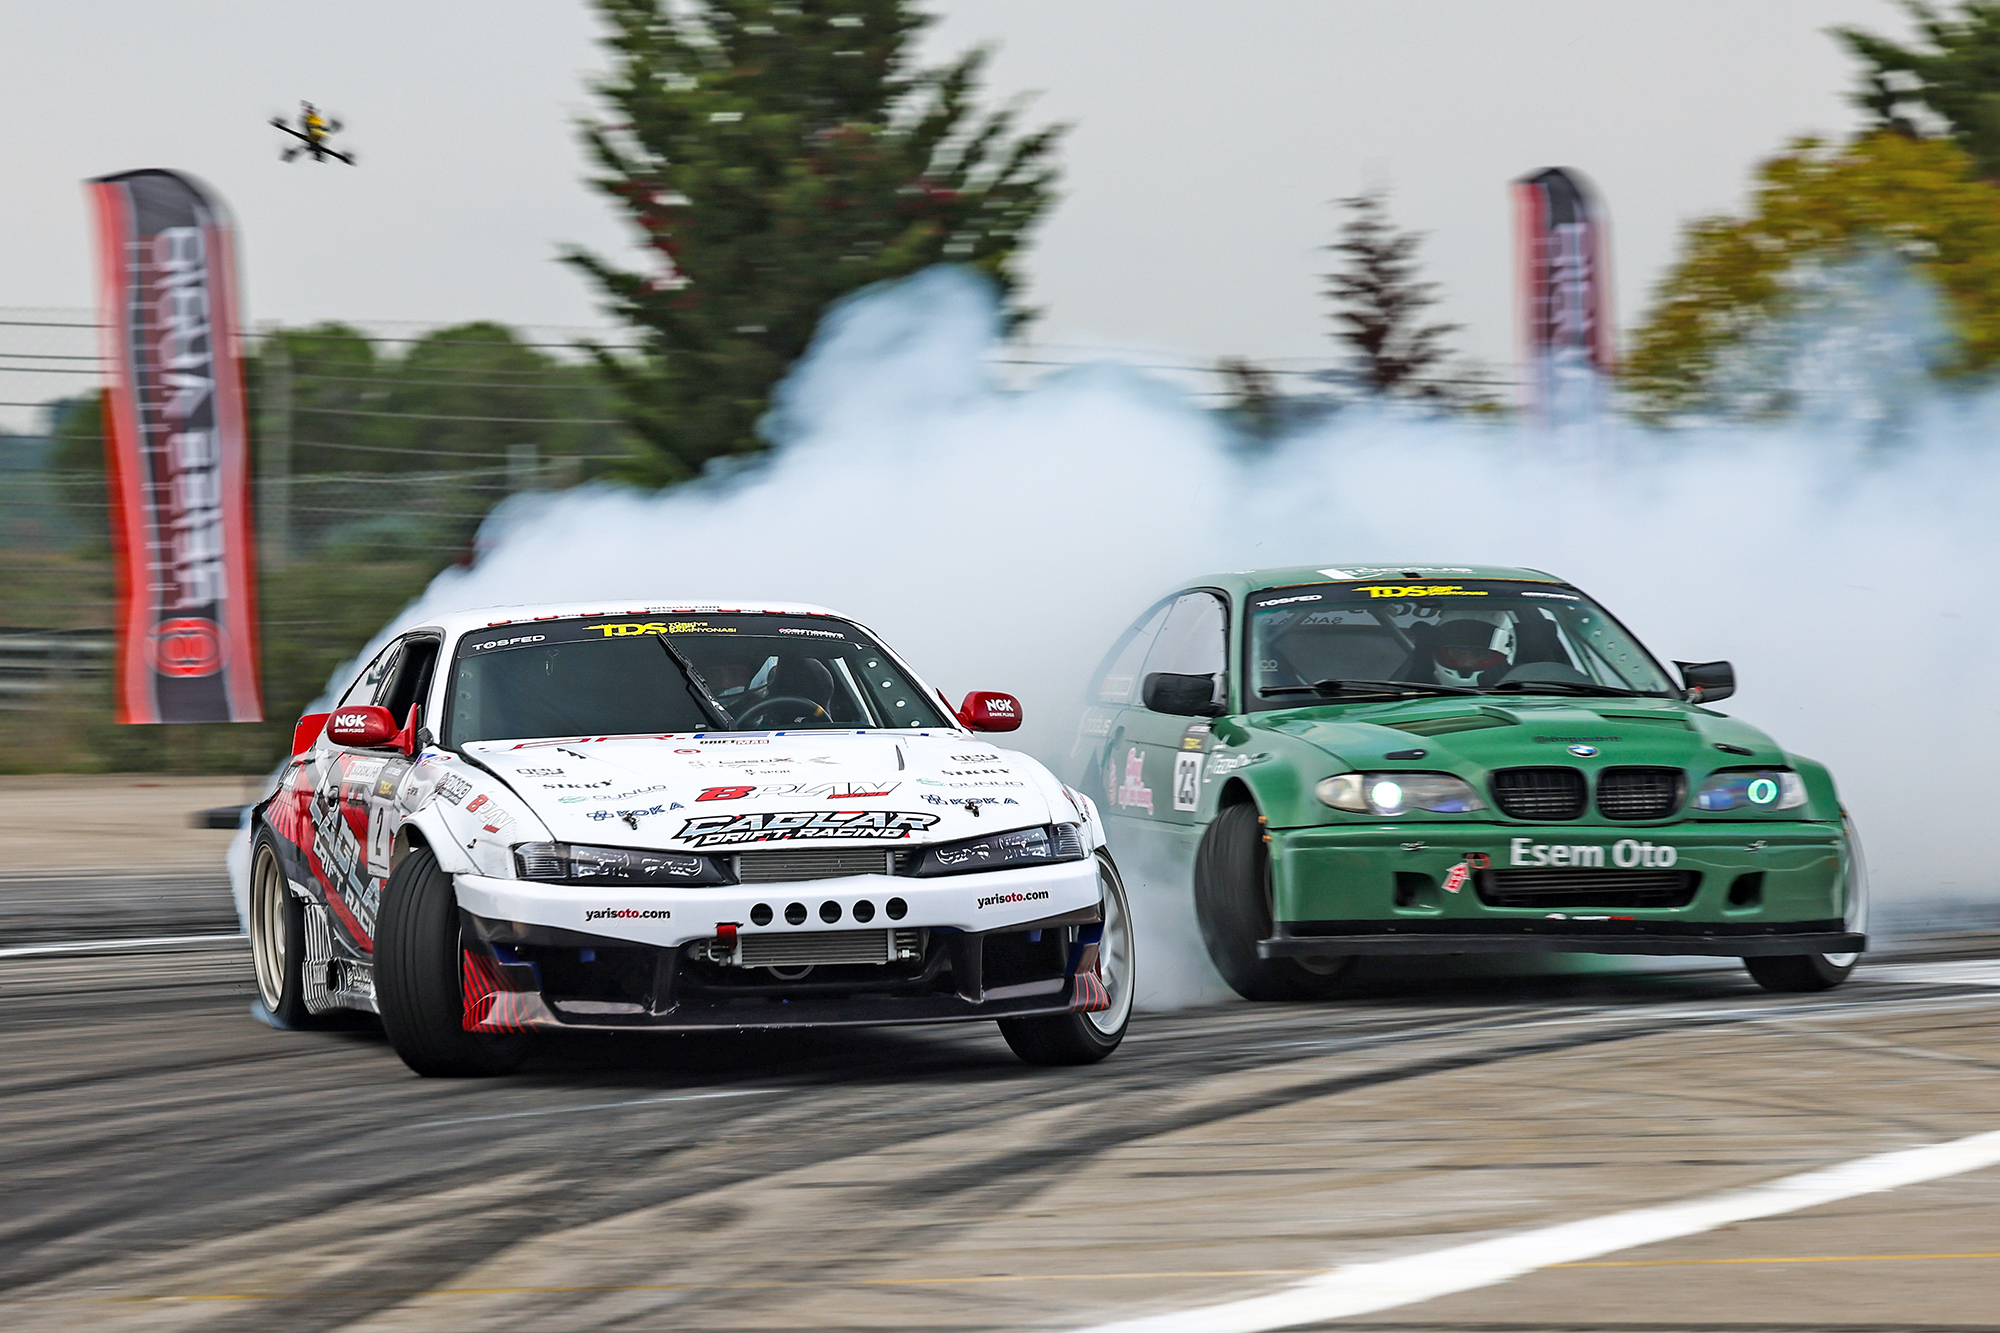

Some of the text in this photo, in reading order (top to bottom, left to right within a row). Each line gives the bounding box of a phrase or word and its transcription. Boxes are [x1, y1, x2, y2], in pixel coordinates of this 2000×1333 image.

[1352, 585, 1428, 598] TDS
[582, 622, 668, 638] TDS
[471, 634, 546, 652] TOSFED
[985, 698, 1014, 711] NGK
[334, 714, 368, 728] NGK
[1178, 759, 1197, 805] 23
[376, 806, 384, 857] 2
[700, 827, 905, 846] DRIFT RACING
[1510, 837, 1678, 868] Esem Oto
[977, 890, 1049, 909] yarisoto.com
[585, 907, 671, 922] yarisoto.com
